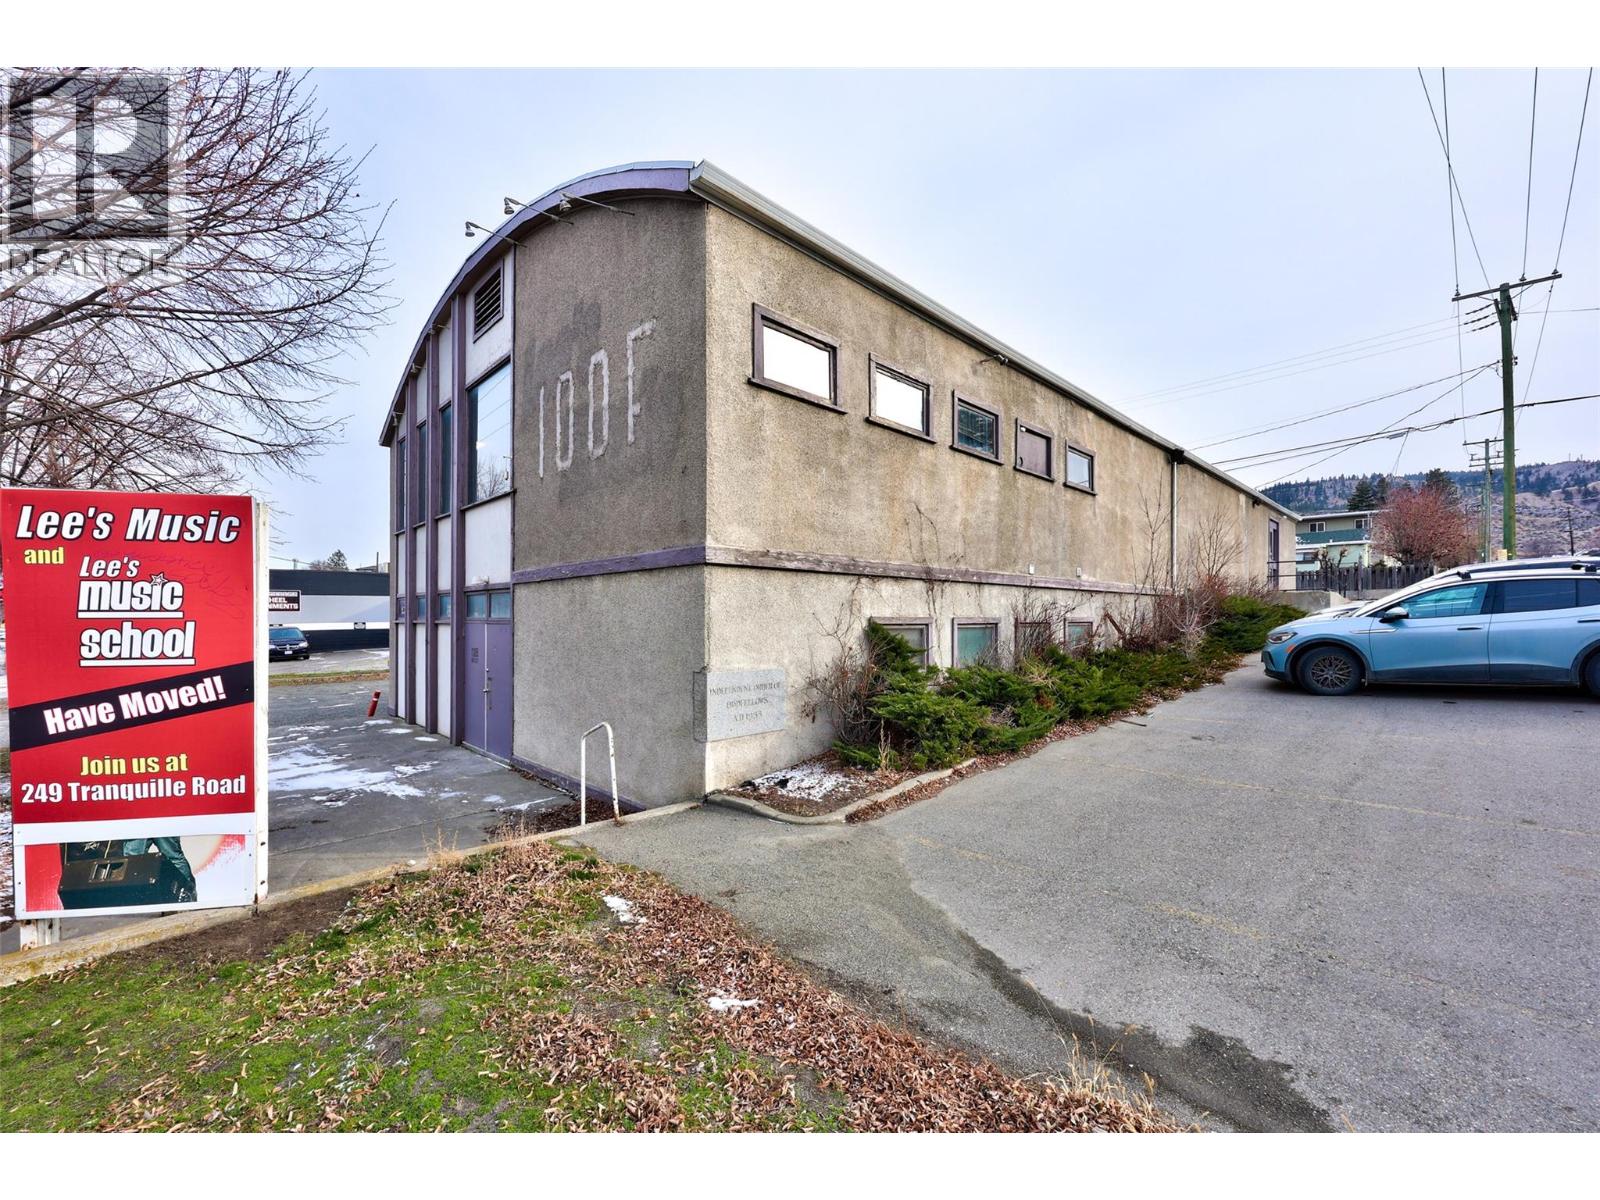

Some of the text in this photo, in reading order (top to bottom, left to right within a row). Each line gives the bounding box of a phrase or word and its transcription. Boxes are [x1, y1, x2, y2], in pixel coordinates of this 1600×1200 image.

[16, 505, 240, 542] Lee's Music
[24, 547, 64, 564] and
[79, 556, 140, 578] Lee's
[78, 574, 183, 611] music
[80, 621, 195, 659] school
[43, 675, 227, 735] Have Moved!
[80, 753, 188, 776] Join us at
[21, 775, 246, 804] 249 Tranquille Road
